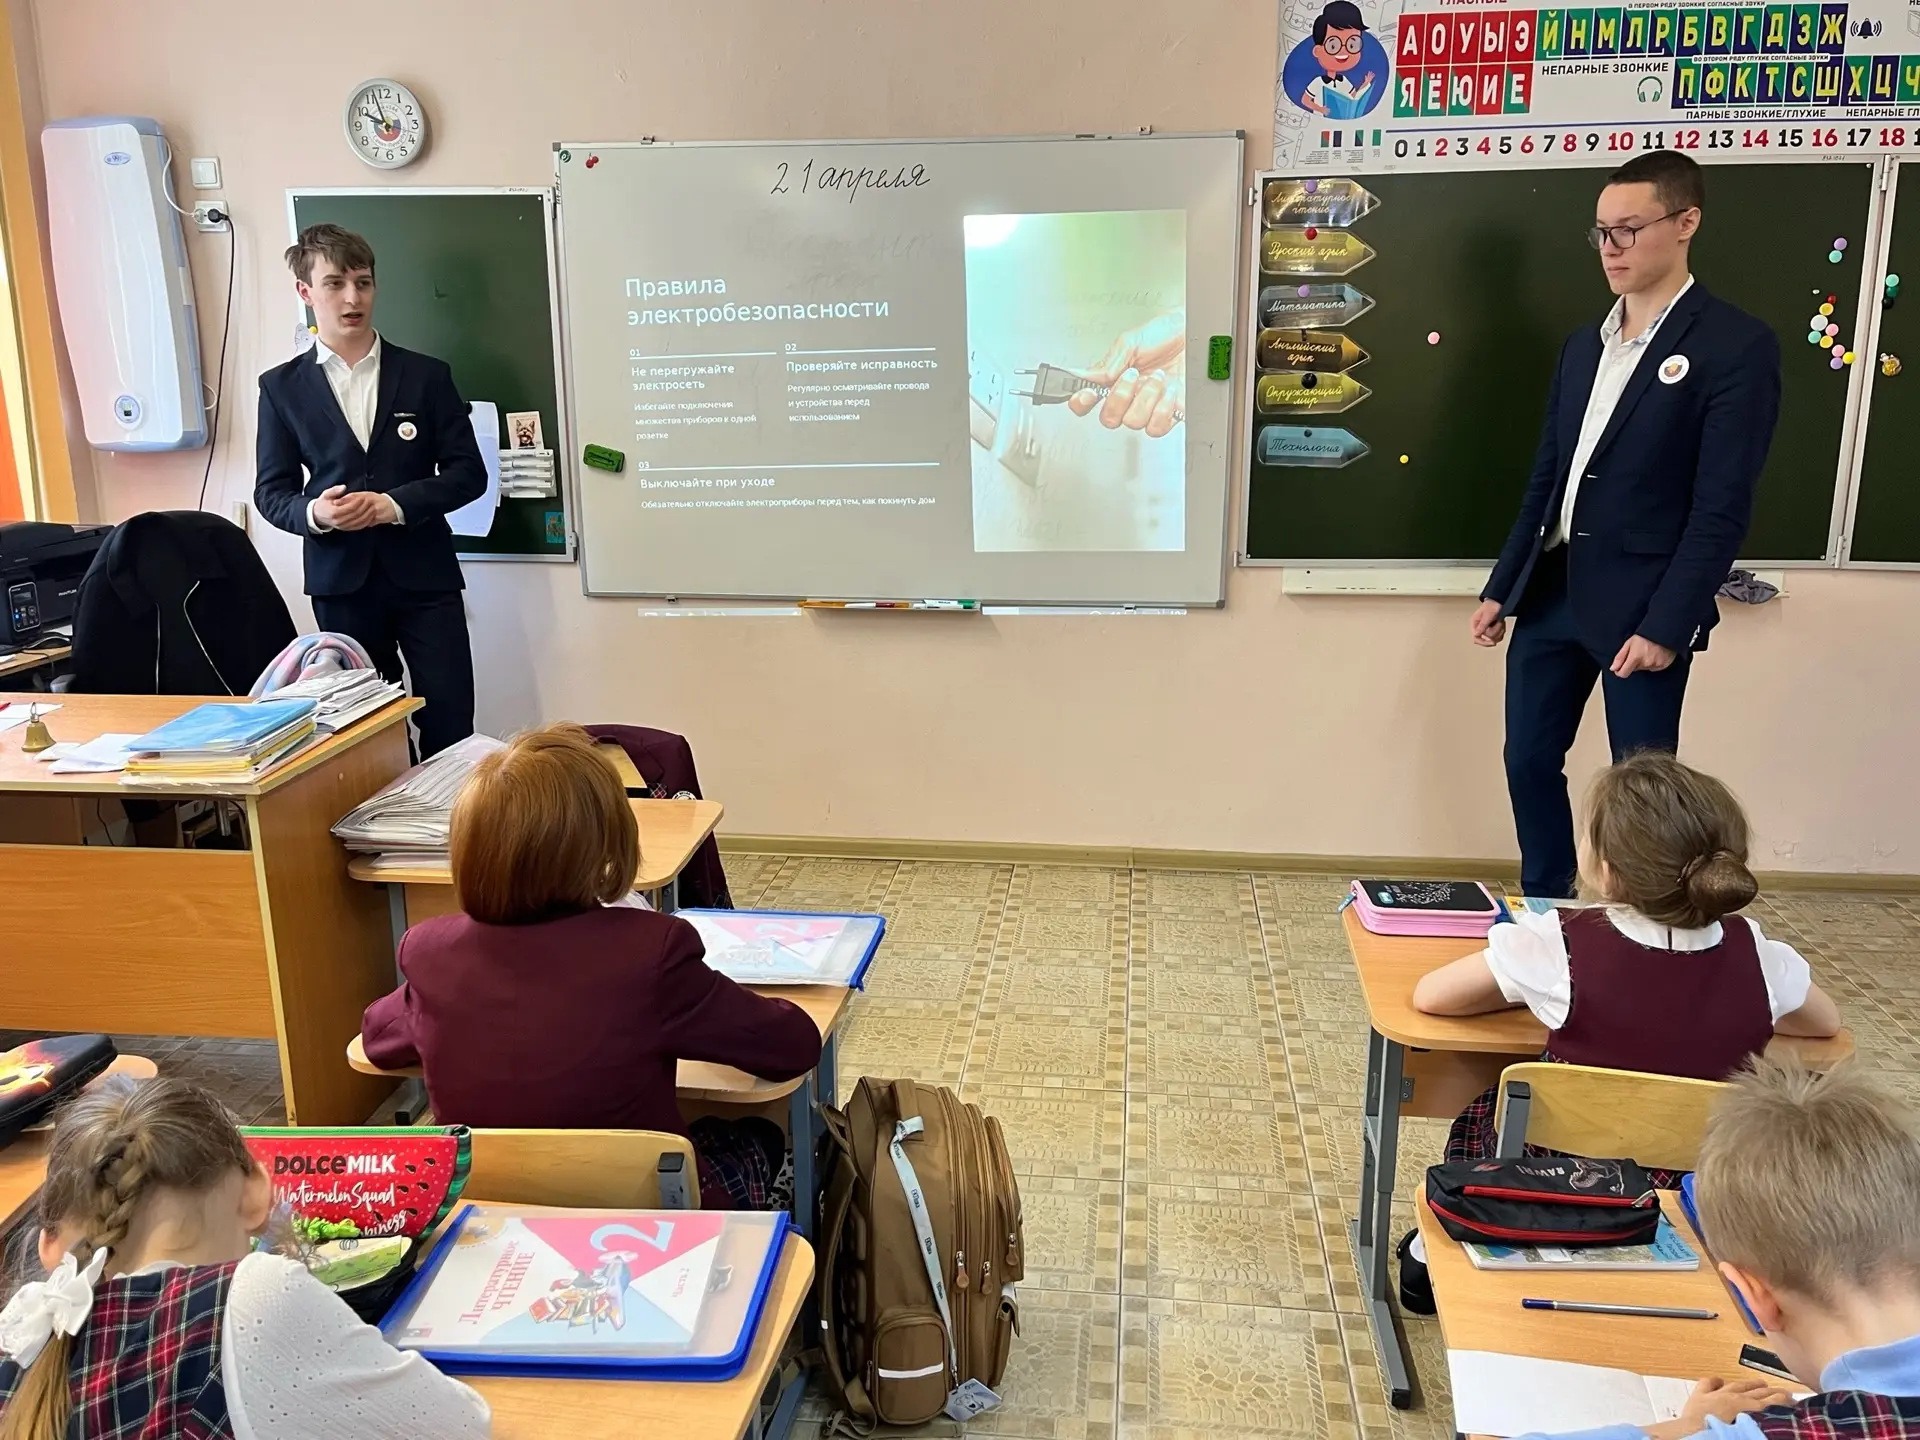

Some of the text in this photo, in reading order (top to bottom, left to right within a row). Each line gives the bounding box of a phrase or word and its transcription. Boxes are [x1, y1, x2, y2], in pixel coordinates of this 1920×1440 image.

[1542, 62, 1669, 75] НЕПАРНЫЕ ЗВОНКИЕ
[378, 88, 391, 99] 12
[397, 93, 401, 103] 1
[358, 107, 369, 117] 10
[405, 105, 413, 115] 2
[1686, 109, 1826, 119] ПАРНЫЕ ЗВОНКИЕ/ГЛУХИЕ
[1846, 108, 1904, 117] НЕПАРНЫЕ
[354, 121, 362, 131] 9
[412, 119, 419, 130] 3
[362, 136, 369, 146] 8
[408, 135, 416, 144] 4
[1395, 139, 1408, 158] 0
[1416, 139, 1426, 157] 1
[1435, 138, 1448, 157] 2
[1456, 138, 1469, 156] 3
[1477, 137, 1491, 155] 4
[1500, 136, 1512, 154] 5
[1520, 136, 1534, 154] 6
[1544, 135, 1556, 153] 7
[1563, 134, 1577, 152] 8
[1586, 133, 1600, 152] 9
[1608, 132, 1634, 151] 10
[1643, 132, 1665, 150] 11
[1674, 131, 1700, 149] 12
[1708, 130, 1734, 149] 13
[1742, 130, 1769, 148] 14
[1778, 129, 1803, 147] 15
[1812, 128, 1838, 147] 16
[1847, 129, 1871, 146] 17
[1879, 128, 1905, 146] 18
[372, 147, 379, 157] 7
[386, 150, 394, 160] 6
[400, 146, 407, 156] 5
[818, 163, 931, 204] апреля
[1268, 242, 1348, 260] Русский язык
[626, 277, 727, 299] Правила
[1267, 300, 1346, 312] Математика
[628, 301, 889, 326] электробезопасности
[1269, 338, 1337, 353] Английский
[1288, 353, 1315, 366] язык
[632, 364, 735, 378] Не перегружайте
[786, 359, 938, 373] Проверяйте исправность
[633, 380, 705, 391] электросеть
[788, 382, 929, 394] Регулярно осматривайте провода
[1266, 386, 1344, 401] Окружающий
[635, 401, 733, 411] Избегайте подключения
[796, 399, 842, 408] устройства
[844, 398, 870, 407] перед
[1293, 397, 1318, 408] мир
[683, 416, 722, 426] приборов
[731, 414, 757, 424] одной
[789, 413, 860, 422] использованием
[636, 432, 669, 441] розетке
[1269, 439, 1341, 453] Технология
[640, 477, 775, 489] Выключайте при уходе
[642, 500, 694, 508] Обязательно
[696, 499, 744, 507] отключайте
[746, 498, 815, 507] электроприборы
[817, 498, 842, 507] перед
[878, 497, 916, 506] покинуть
[918, 497, 935, 505] дом
[274, 1179, 396, 1212] Watermelon Squad
[590, 1220, 675, 1253] 2
[491, 1252, 536, 1311] ЧТЕНИЕ
